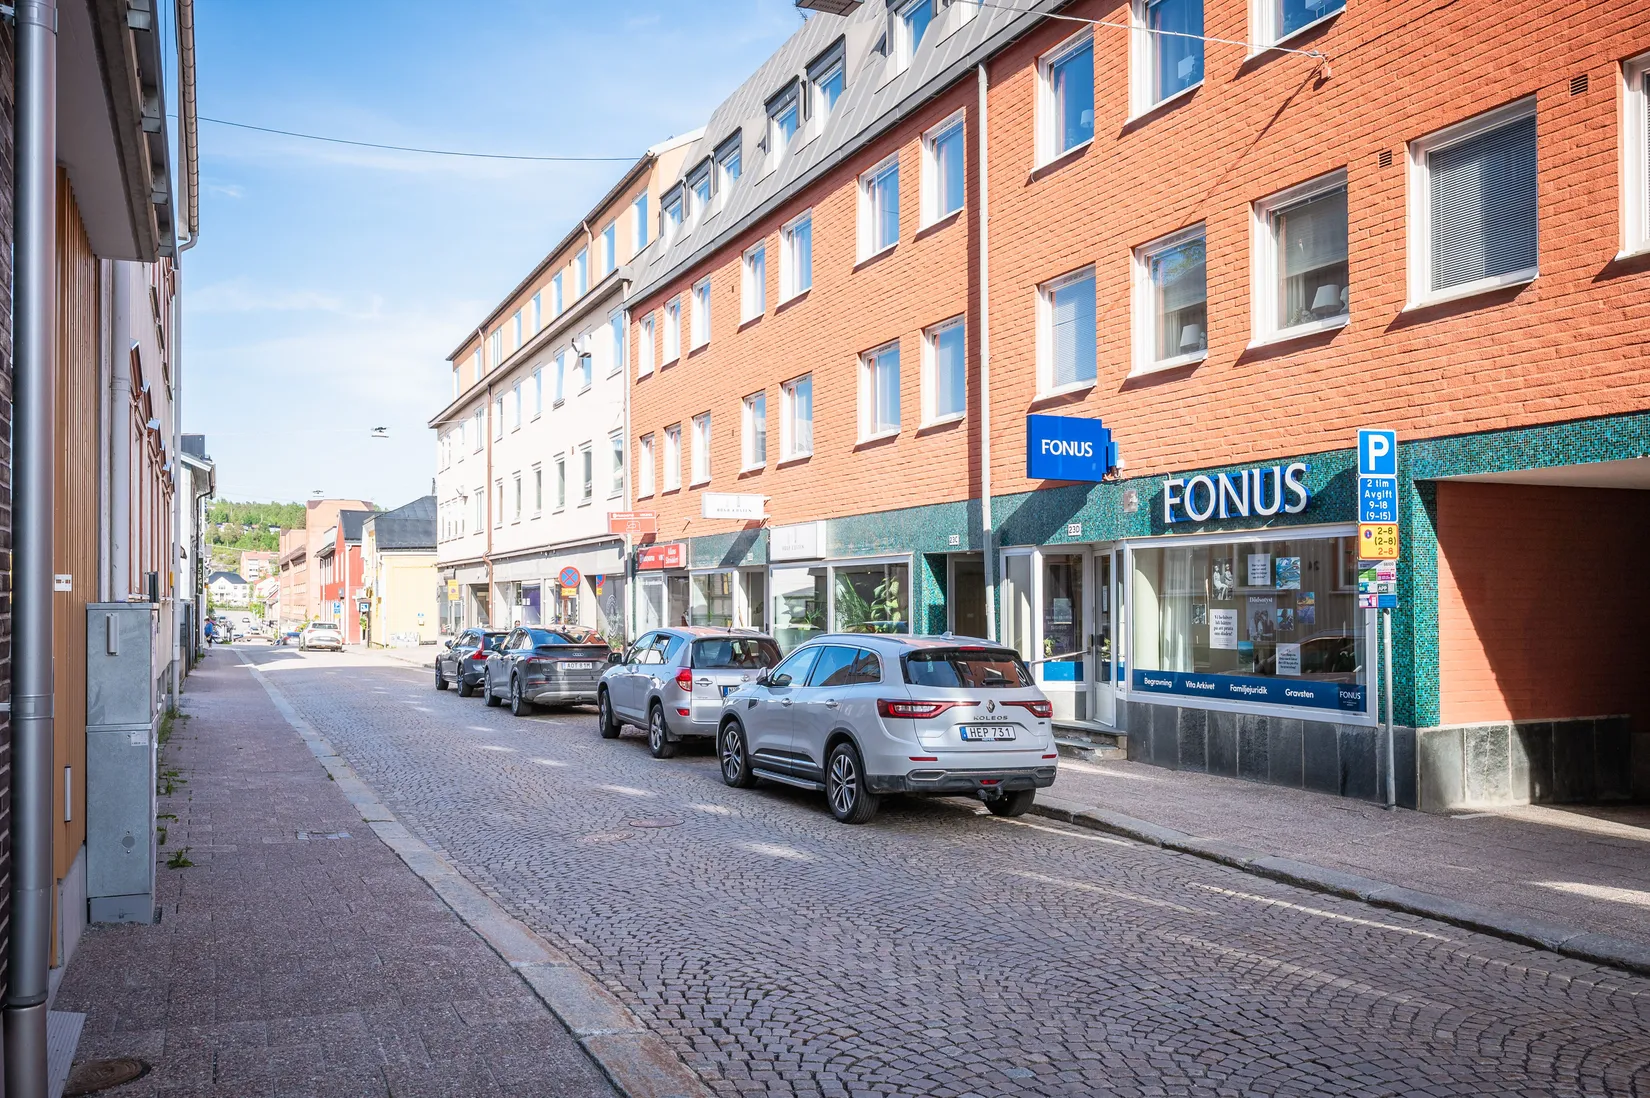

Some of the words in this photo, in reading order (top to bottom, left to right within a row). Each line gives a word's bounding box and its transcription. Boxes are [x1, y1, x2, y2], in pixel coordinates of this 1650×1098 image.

[1041, 438, 1093, 457] FONUS
[1368, 434, 1389, 471] P
[1367, 479, 1373, 488] 2
[1375, 479, 1389, 488] tim
[1163, 462, 1309, 523] FONUS
[1364, 489, 1392, 500] Avgift
[1369, 500, 1388, 509] 9-18
[1366, 511, 1391, 520] (9-15)
[1377, 526, 1393, 535] 2-8
[1374, 536, 1396, 546] (2-8)
[1377, 547, 1394, 556] 2-8
[1144, 677, 1173, 688] Begravning
[1185, 680, 1196, 688] Vita
[1196, 681, 1215, 690] Arkivet
[1229, 684, 1268, 695] Familjejuridik
[1284, 688, 1314, 699] Gravsten
[1339, 690, 1361, 700] FONUS
[969, 727, 989, 737] HEP
[992, 727, 1011, 737] 731
